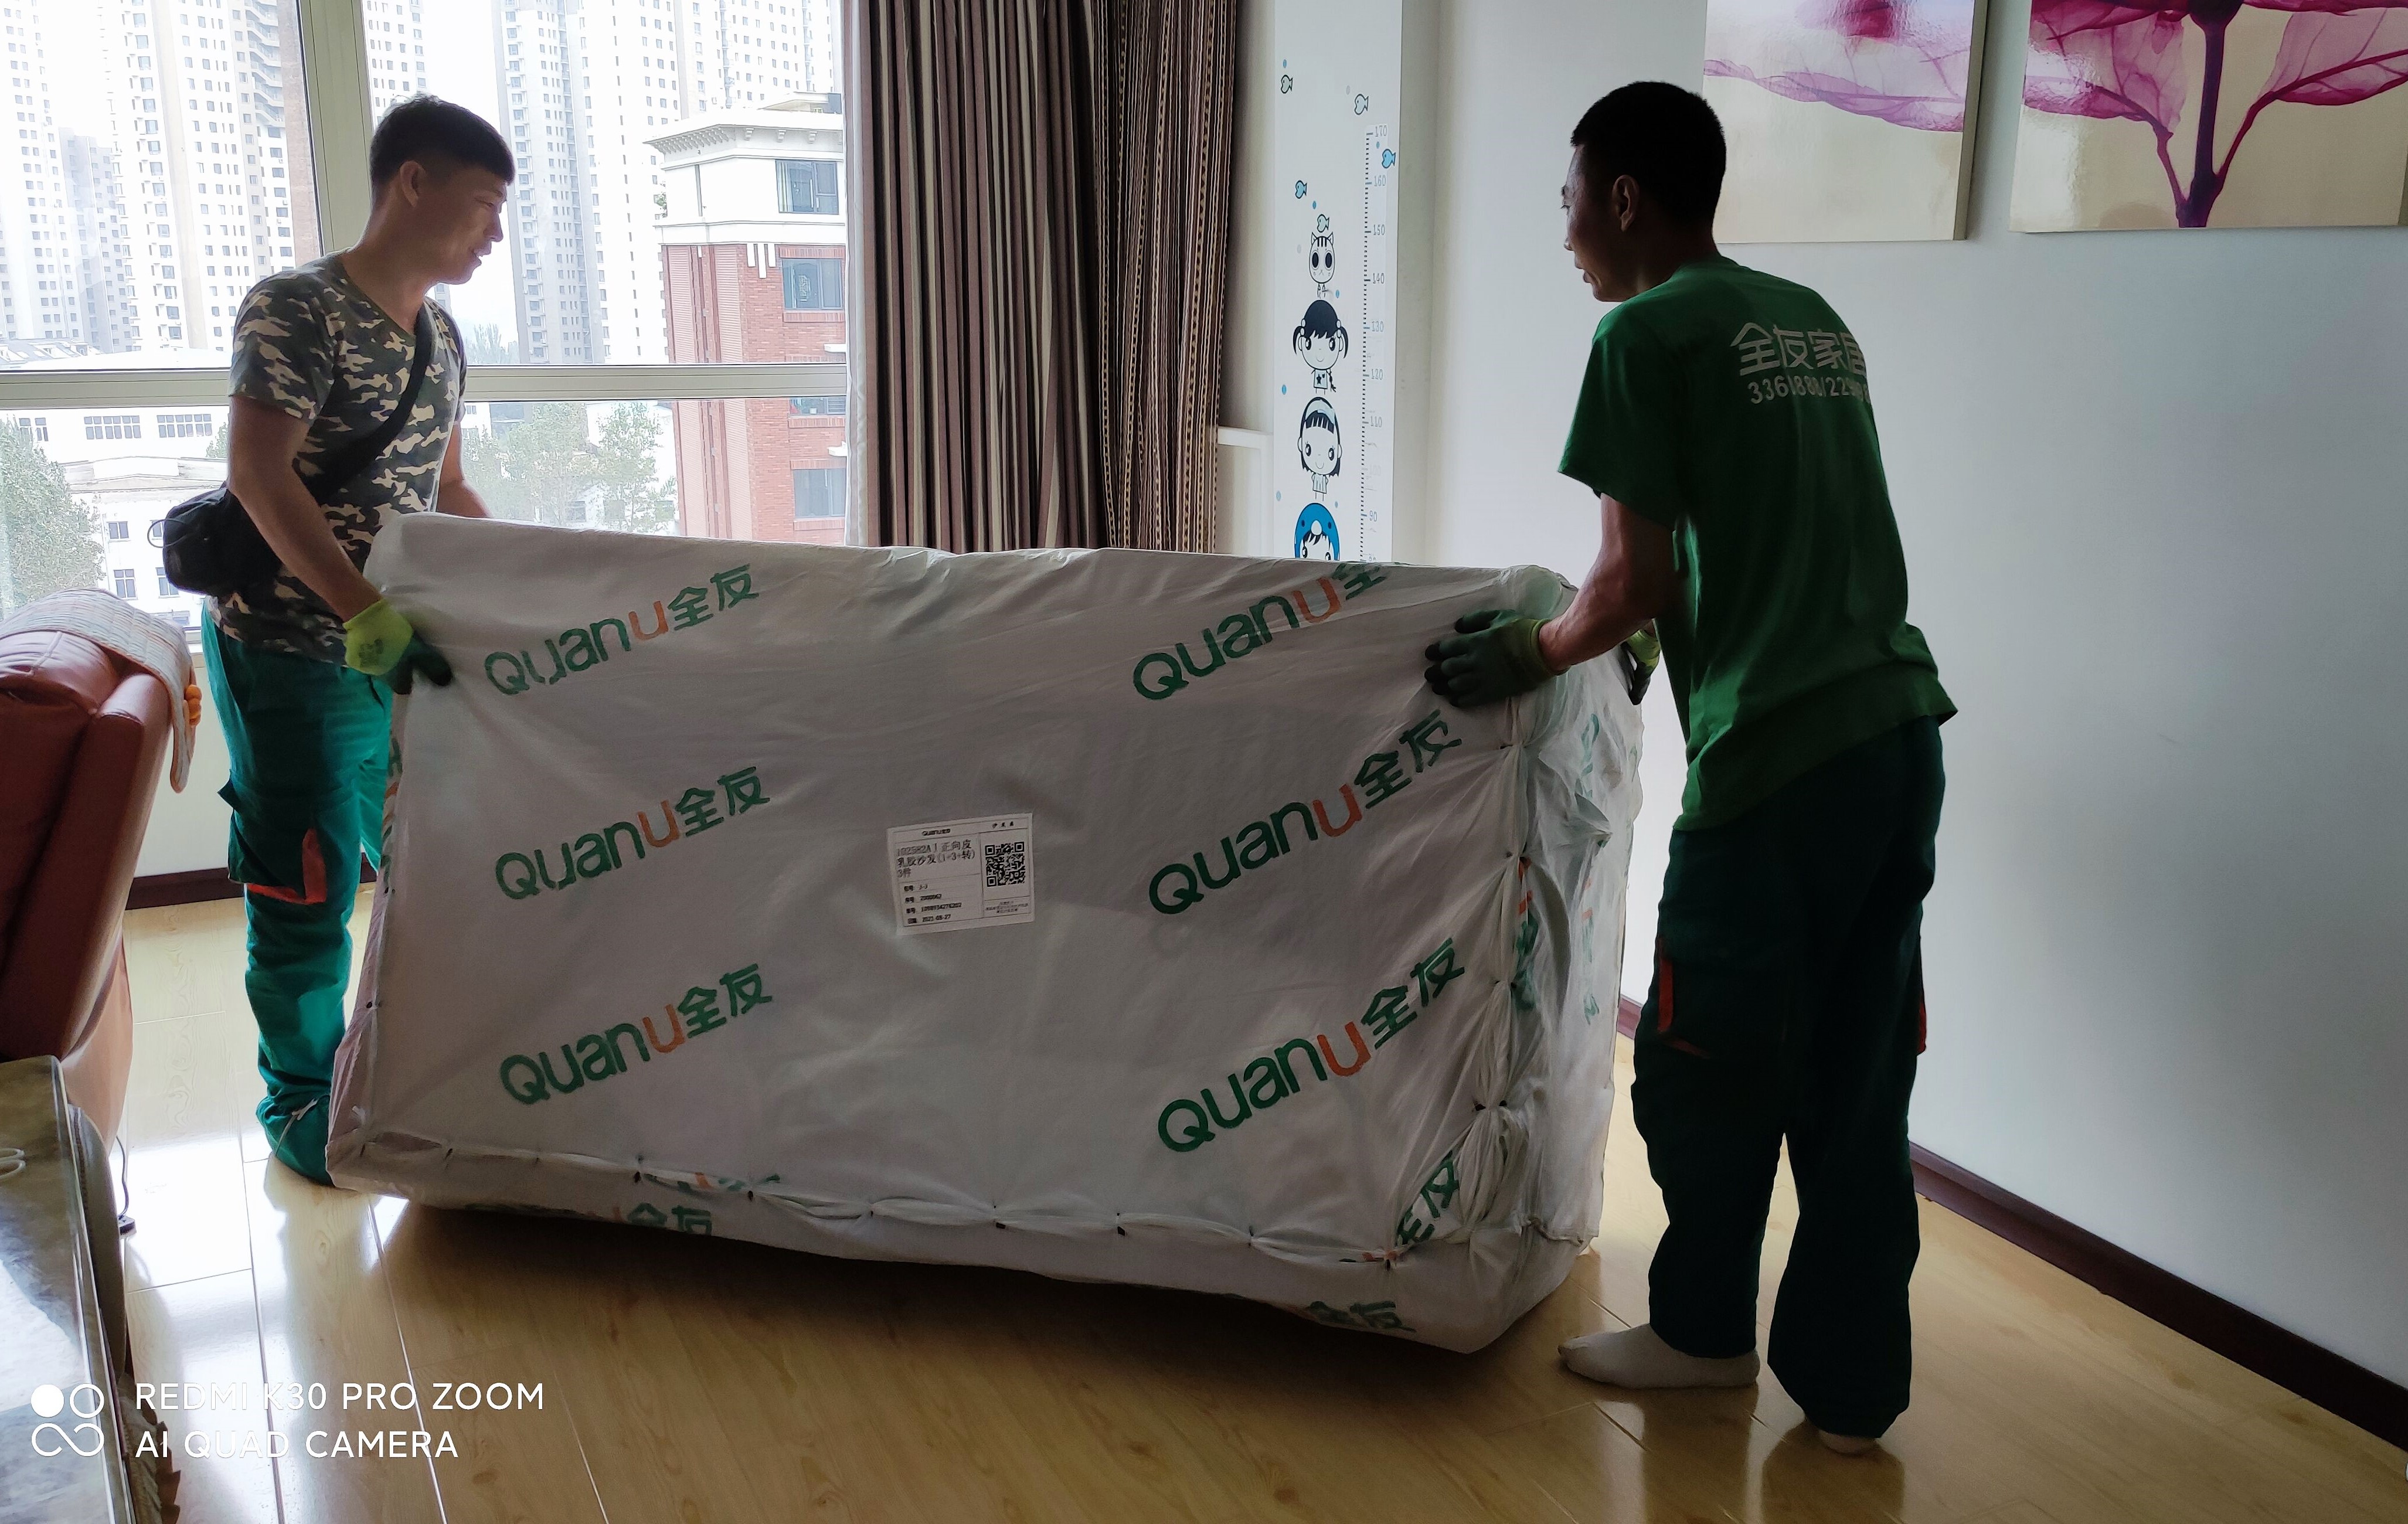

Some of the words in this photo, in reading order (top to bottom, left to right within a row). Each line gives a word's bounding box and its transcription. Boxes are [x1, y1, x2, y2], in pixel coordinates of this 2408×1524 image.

[1375, 125, 1387, 137] 170
[1374, 175, 1386, 186] 160
[1373, 224, 1385, 236] 150
[1372, 273, 1385, 284] 140
[1372, 321, 1384, 332] 130
[1371, 368, 1383, 380] 120
[1370, 416, 1382, 428] 110
[1369, 511, 1378, 522] 90
